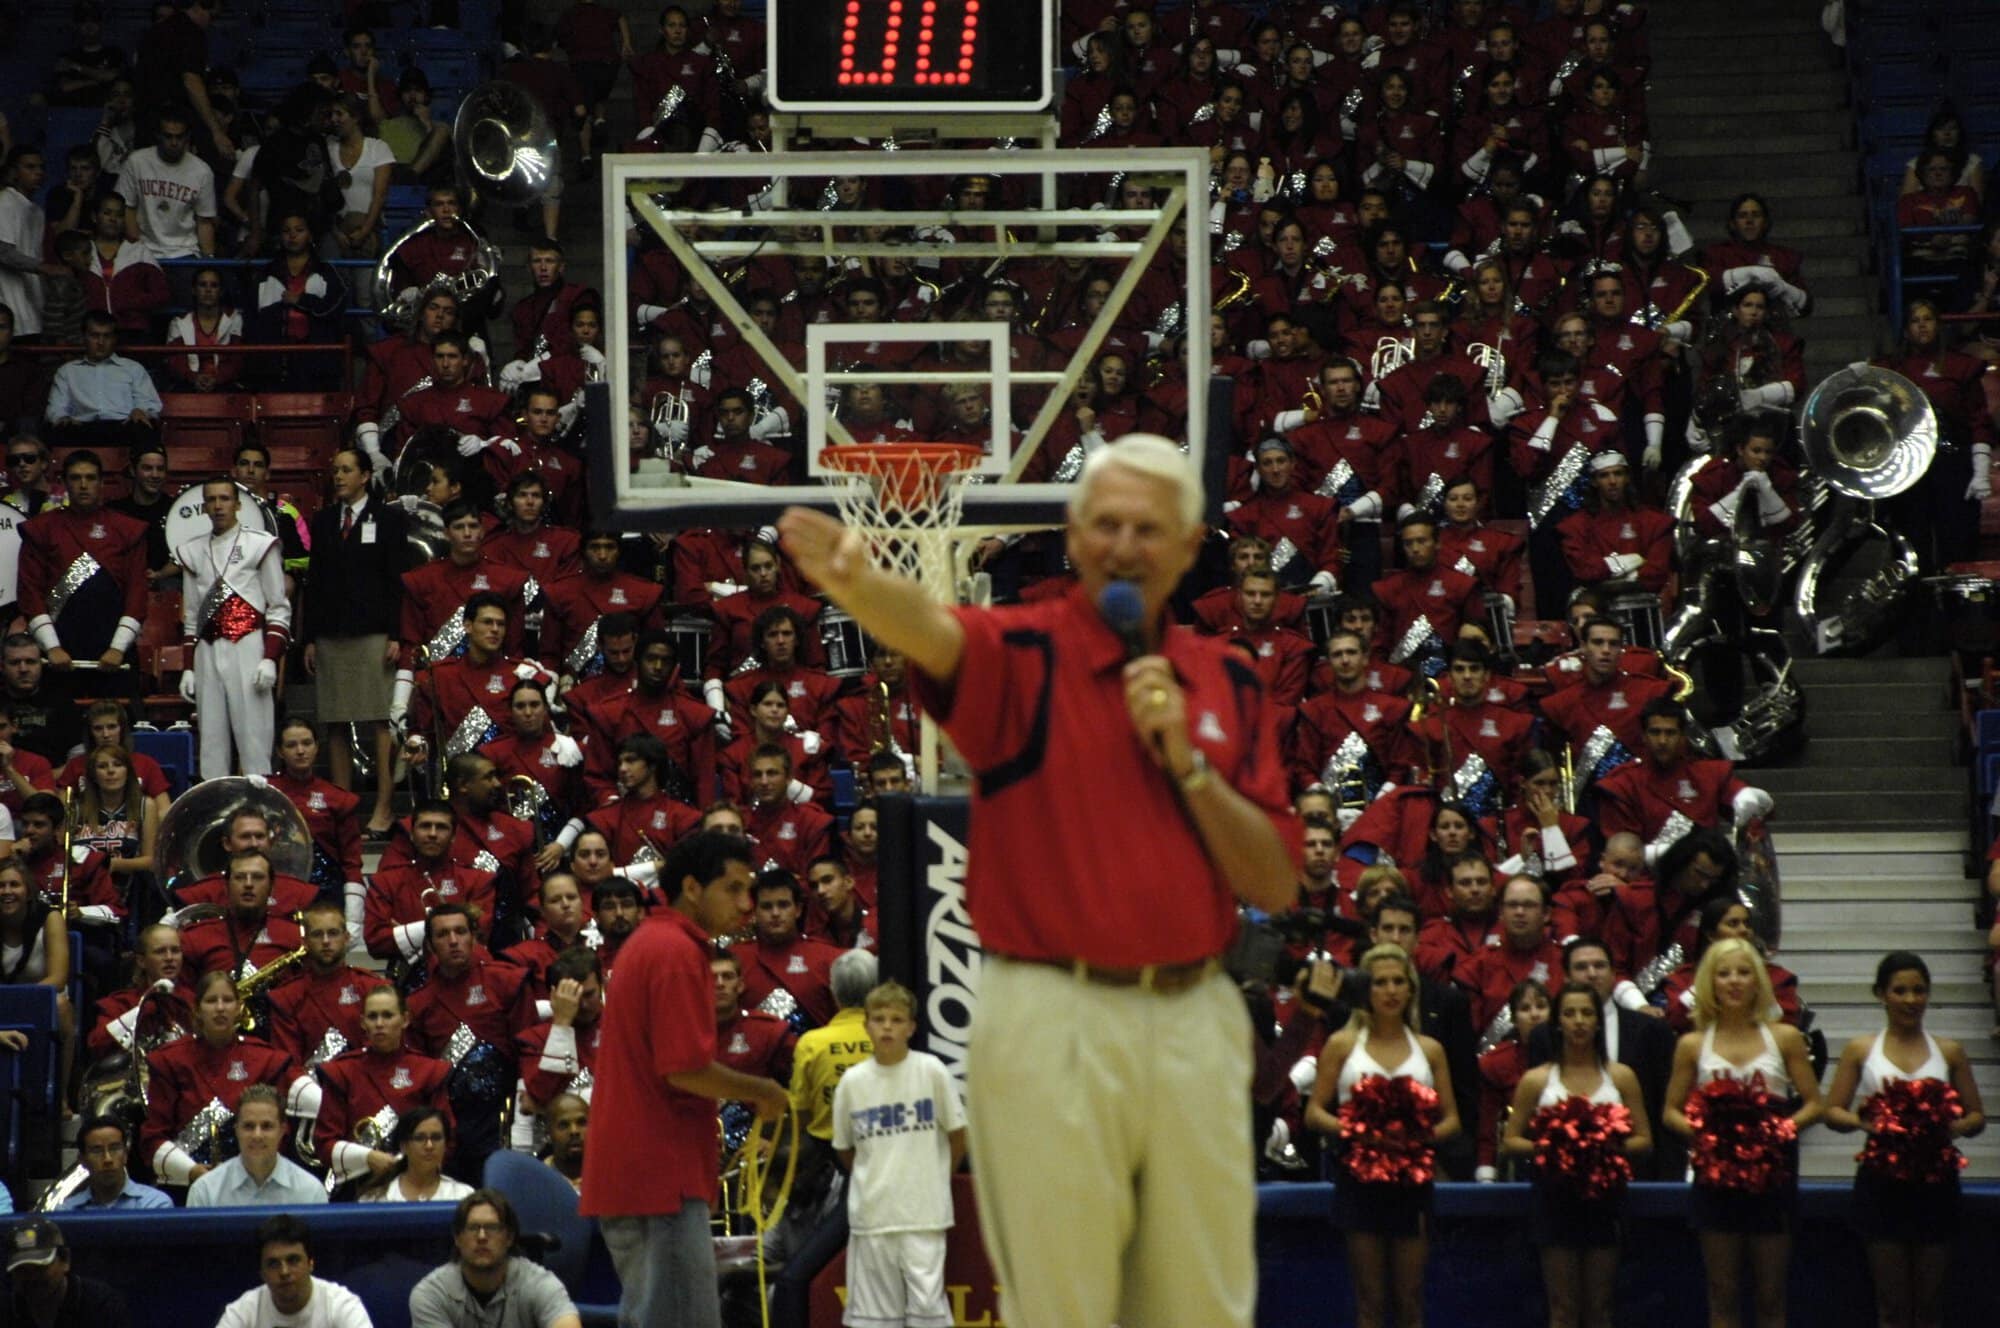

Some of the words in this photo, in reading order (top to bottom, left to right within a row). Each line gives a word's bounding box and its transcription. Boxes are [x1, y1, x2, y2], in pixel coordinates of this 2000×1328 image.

[139, 178, 198, 203] UCKEYES
[927, 820, 982, 1104] ARIZON
[829, 1041, 873, 1055] EVE
